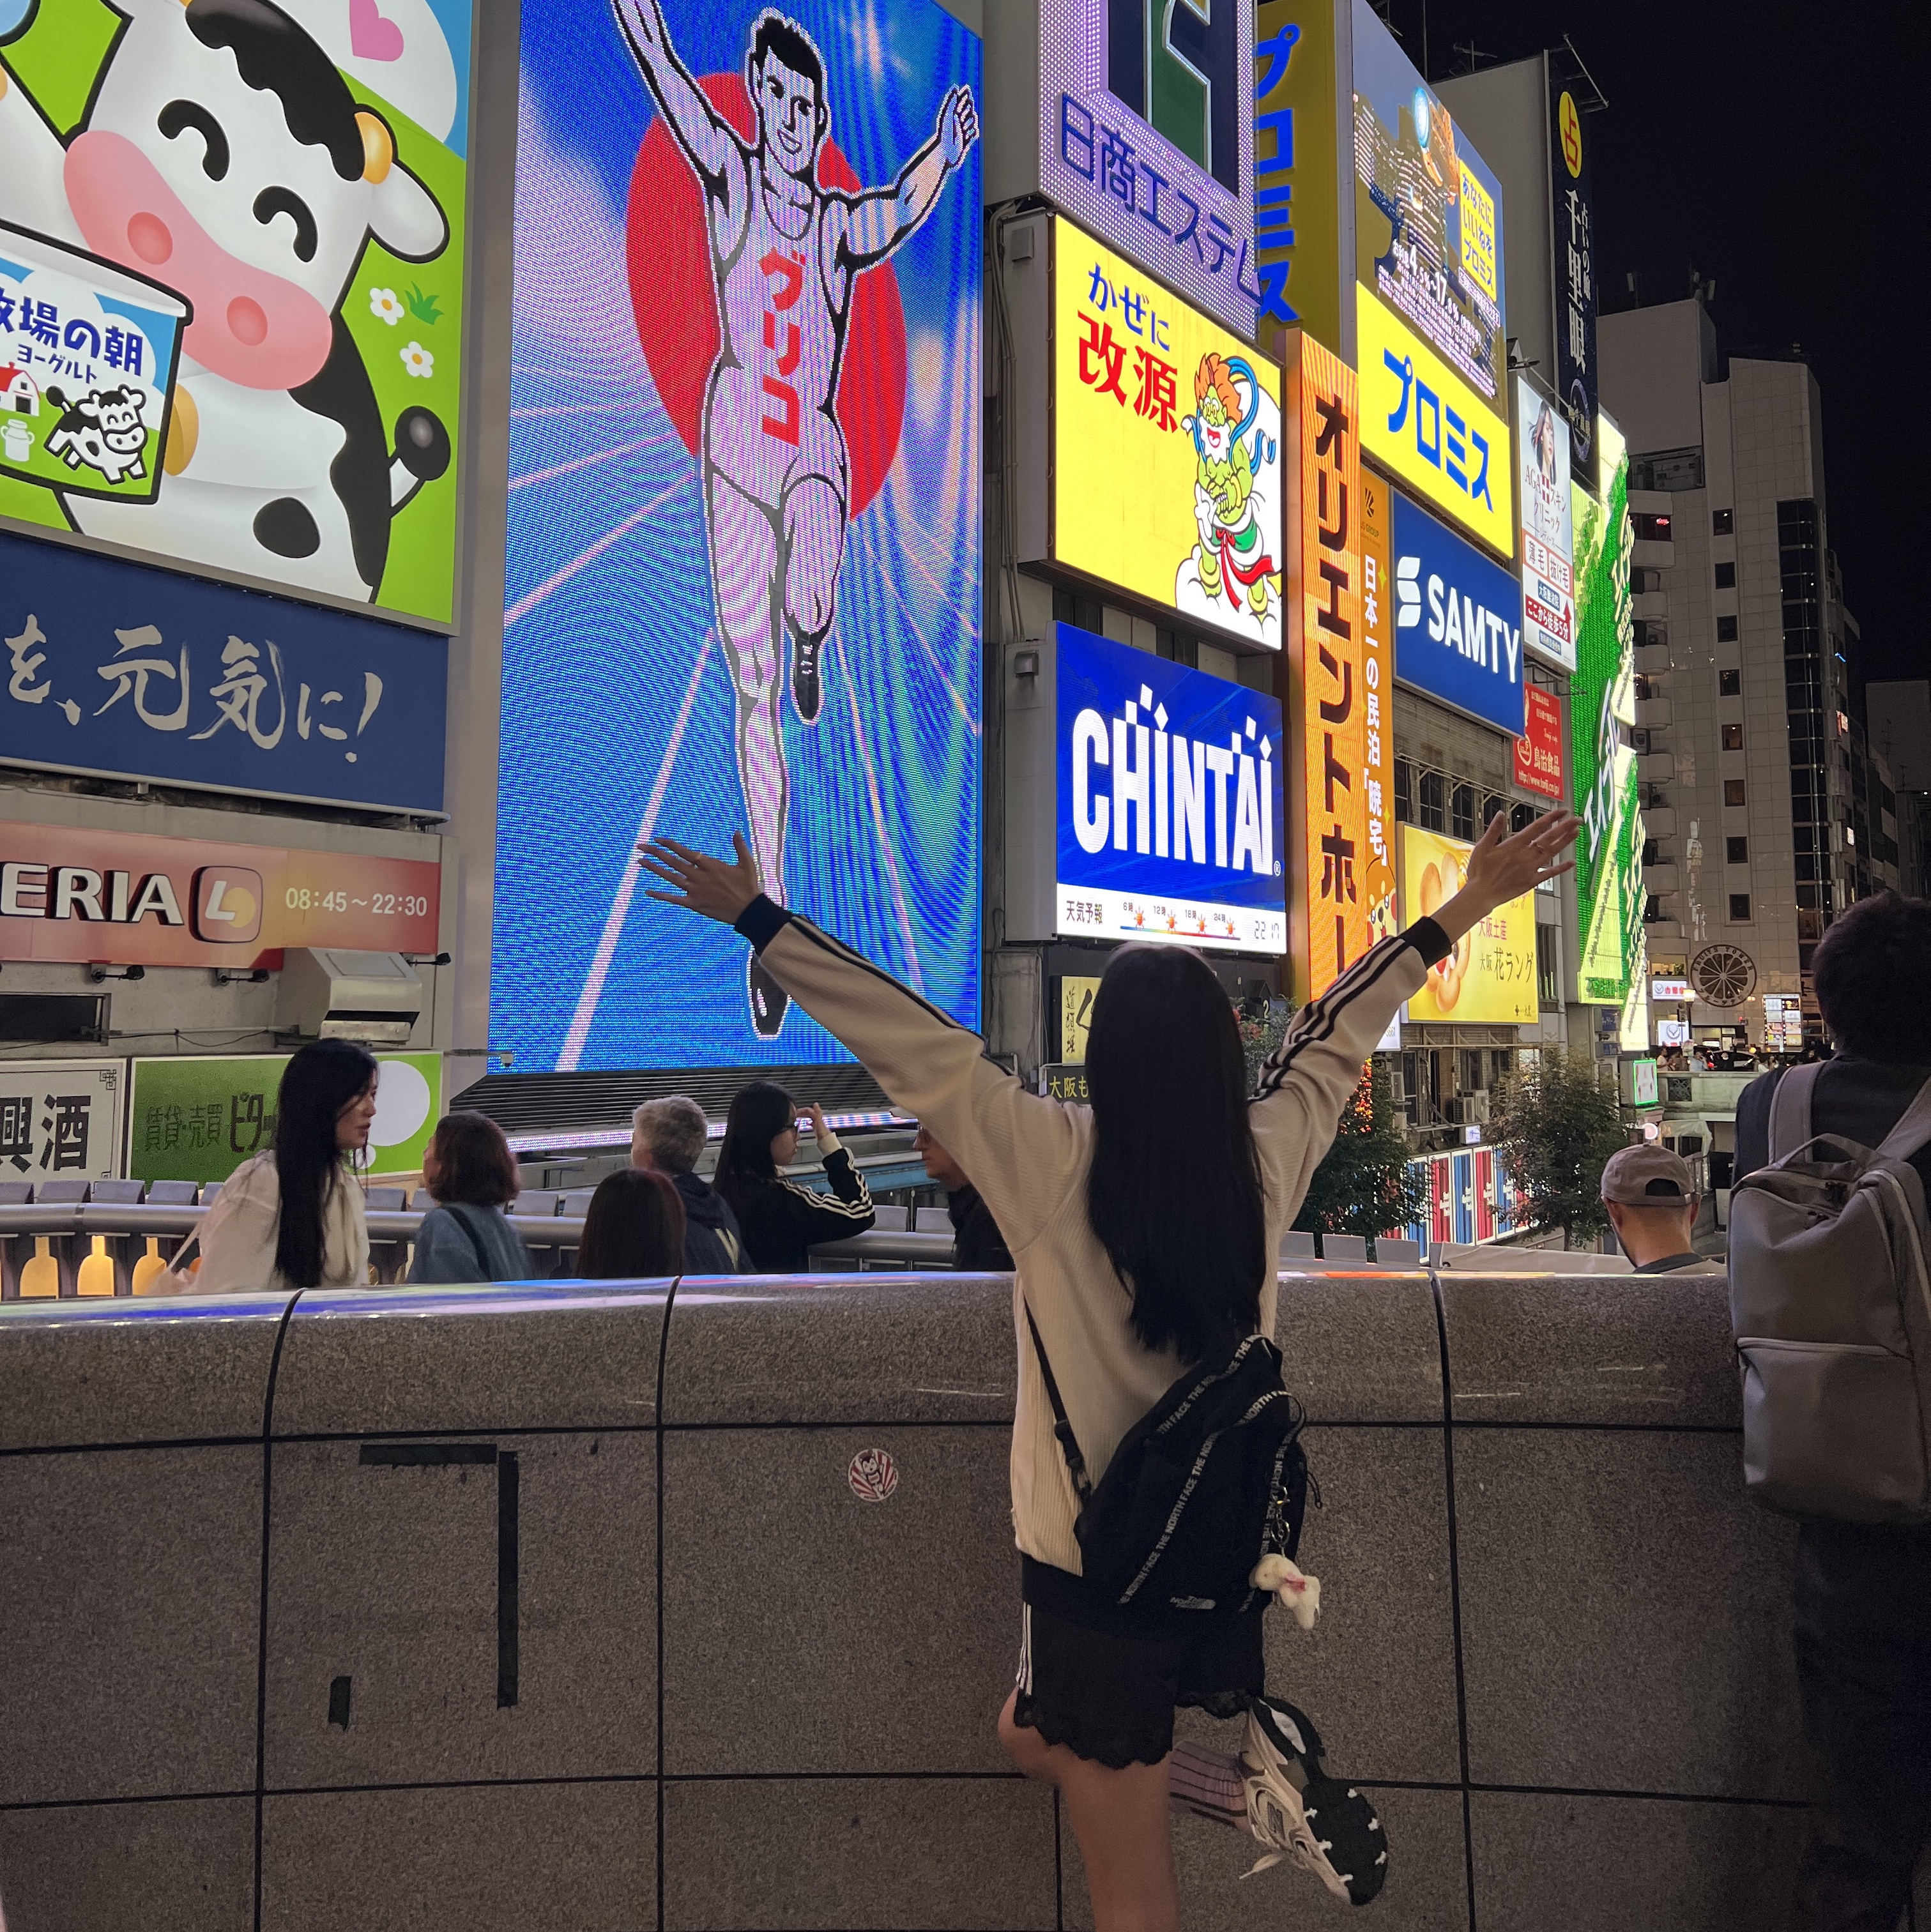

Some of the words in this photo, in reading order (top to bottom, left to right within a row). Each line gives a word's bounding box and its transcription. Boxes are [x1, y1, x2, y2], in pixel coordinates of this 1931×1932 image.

[1255, 23, 1301, 323] プロミス
[1462, 172, 1492, 229] あなたに
[1463, 204, 1492, 261] いいねを
[1464, 237, 1494, 291] プロミス
[1565, 190, 1586, 374] 千里眼
[1088, 262, 1170, 352] かぜに
[17, 343, 97, 384] ヨーグルト
[759, 247, 806, 447] グリコ
[1078, 310, 1178, 434] 改源
[1384, 347, 1494, 513] プロミス
[1534, 499, 1561, 534] クリニック
[1550, 488, 1566, 512] スキン
[1428, 574, 1520, 683] SAMTY
[1072, 703, 1273, 876] CHINTAI
[0, 862, 184, 925] ERIA
[1066, 899, 1103, 925] 天気予報
[1479, 916, 1507, 941] 大阪土産
[1692, 946, 1718, 971] FRUITS
[1725, 946, 1753, 971] TOWER
[1049, 1075, 1089, 1099] 大阪も
[1156, 1533, 1171, 1552] THE
[1164, 1499, 1186, 1535] NORTH
[1179, 1476, 1198, 1502] FACE
[1191, 1457, 1207, 1477] THE
